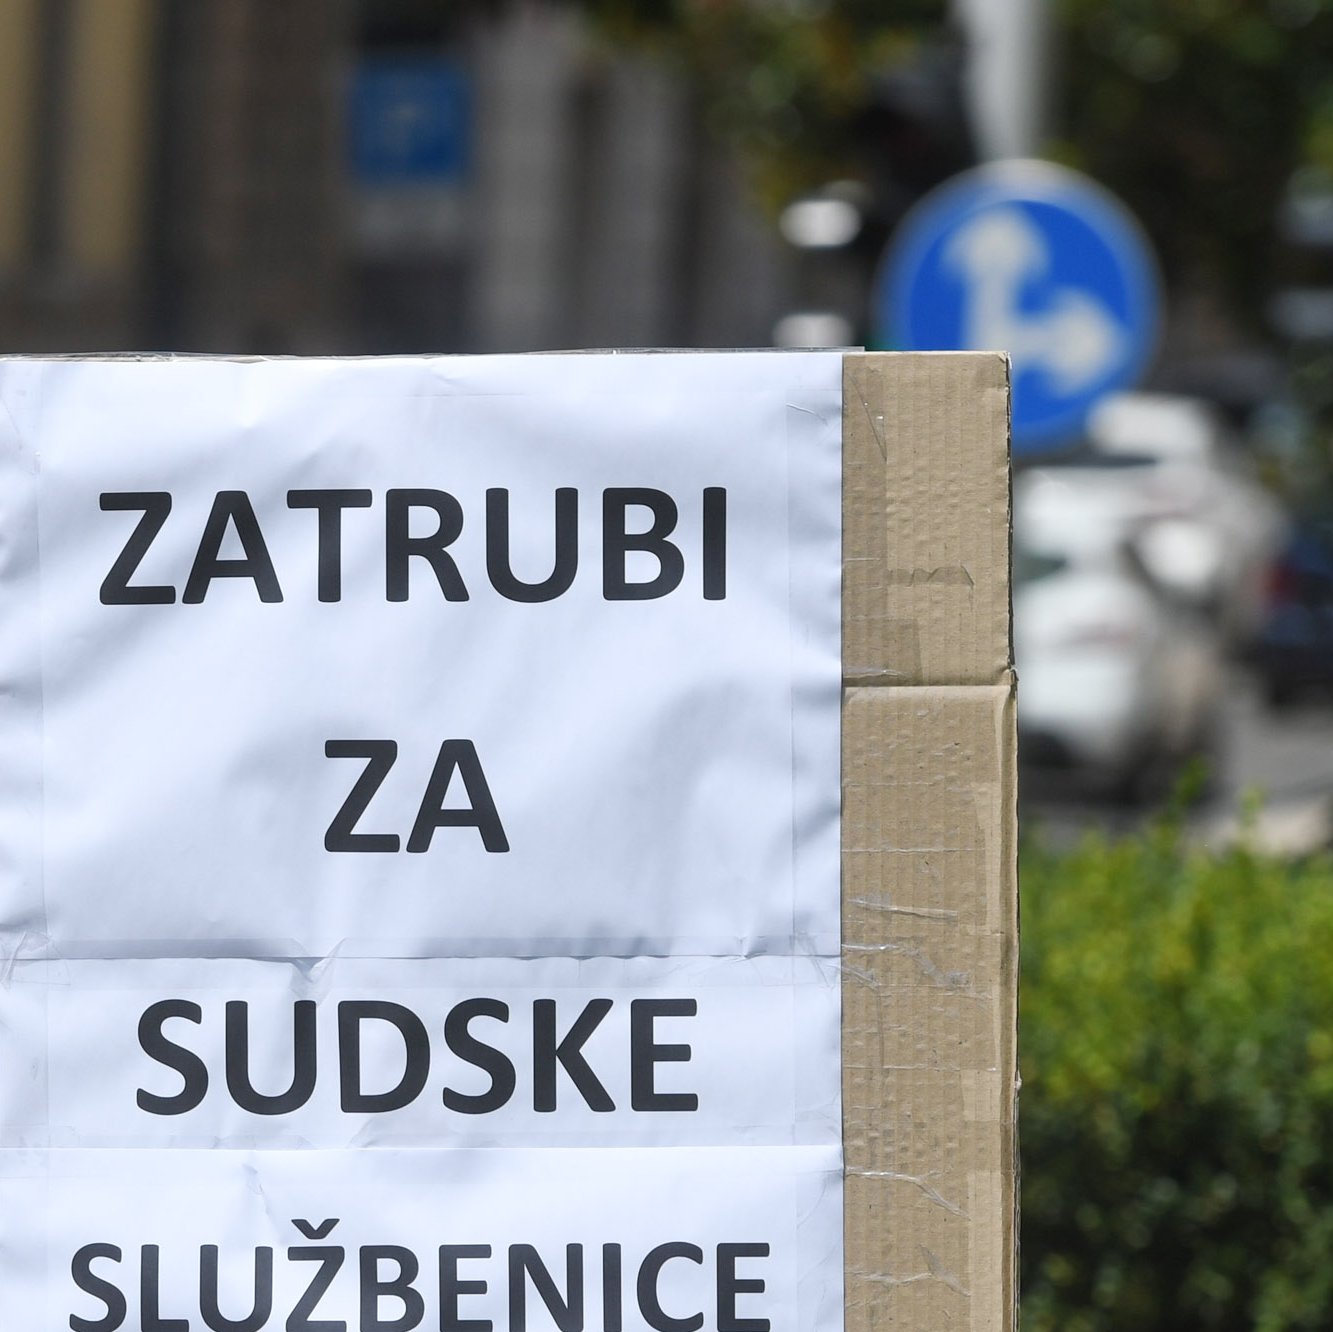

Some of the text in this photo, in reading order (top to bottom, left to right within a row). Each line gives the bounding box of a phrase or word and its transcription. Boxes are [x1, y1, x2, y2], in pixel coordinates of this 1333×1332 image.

[99, 486, 727, 606] ZATRUBI
[324, 739, 510, 854] ZA
[136, 997, 699, 1116] SUDSKE
